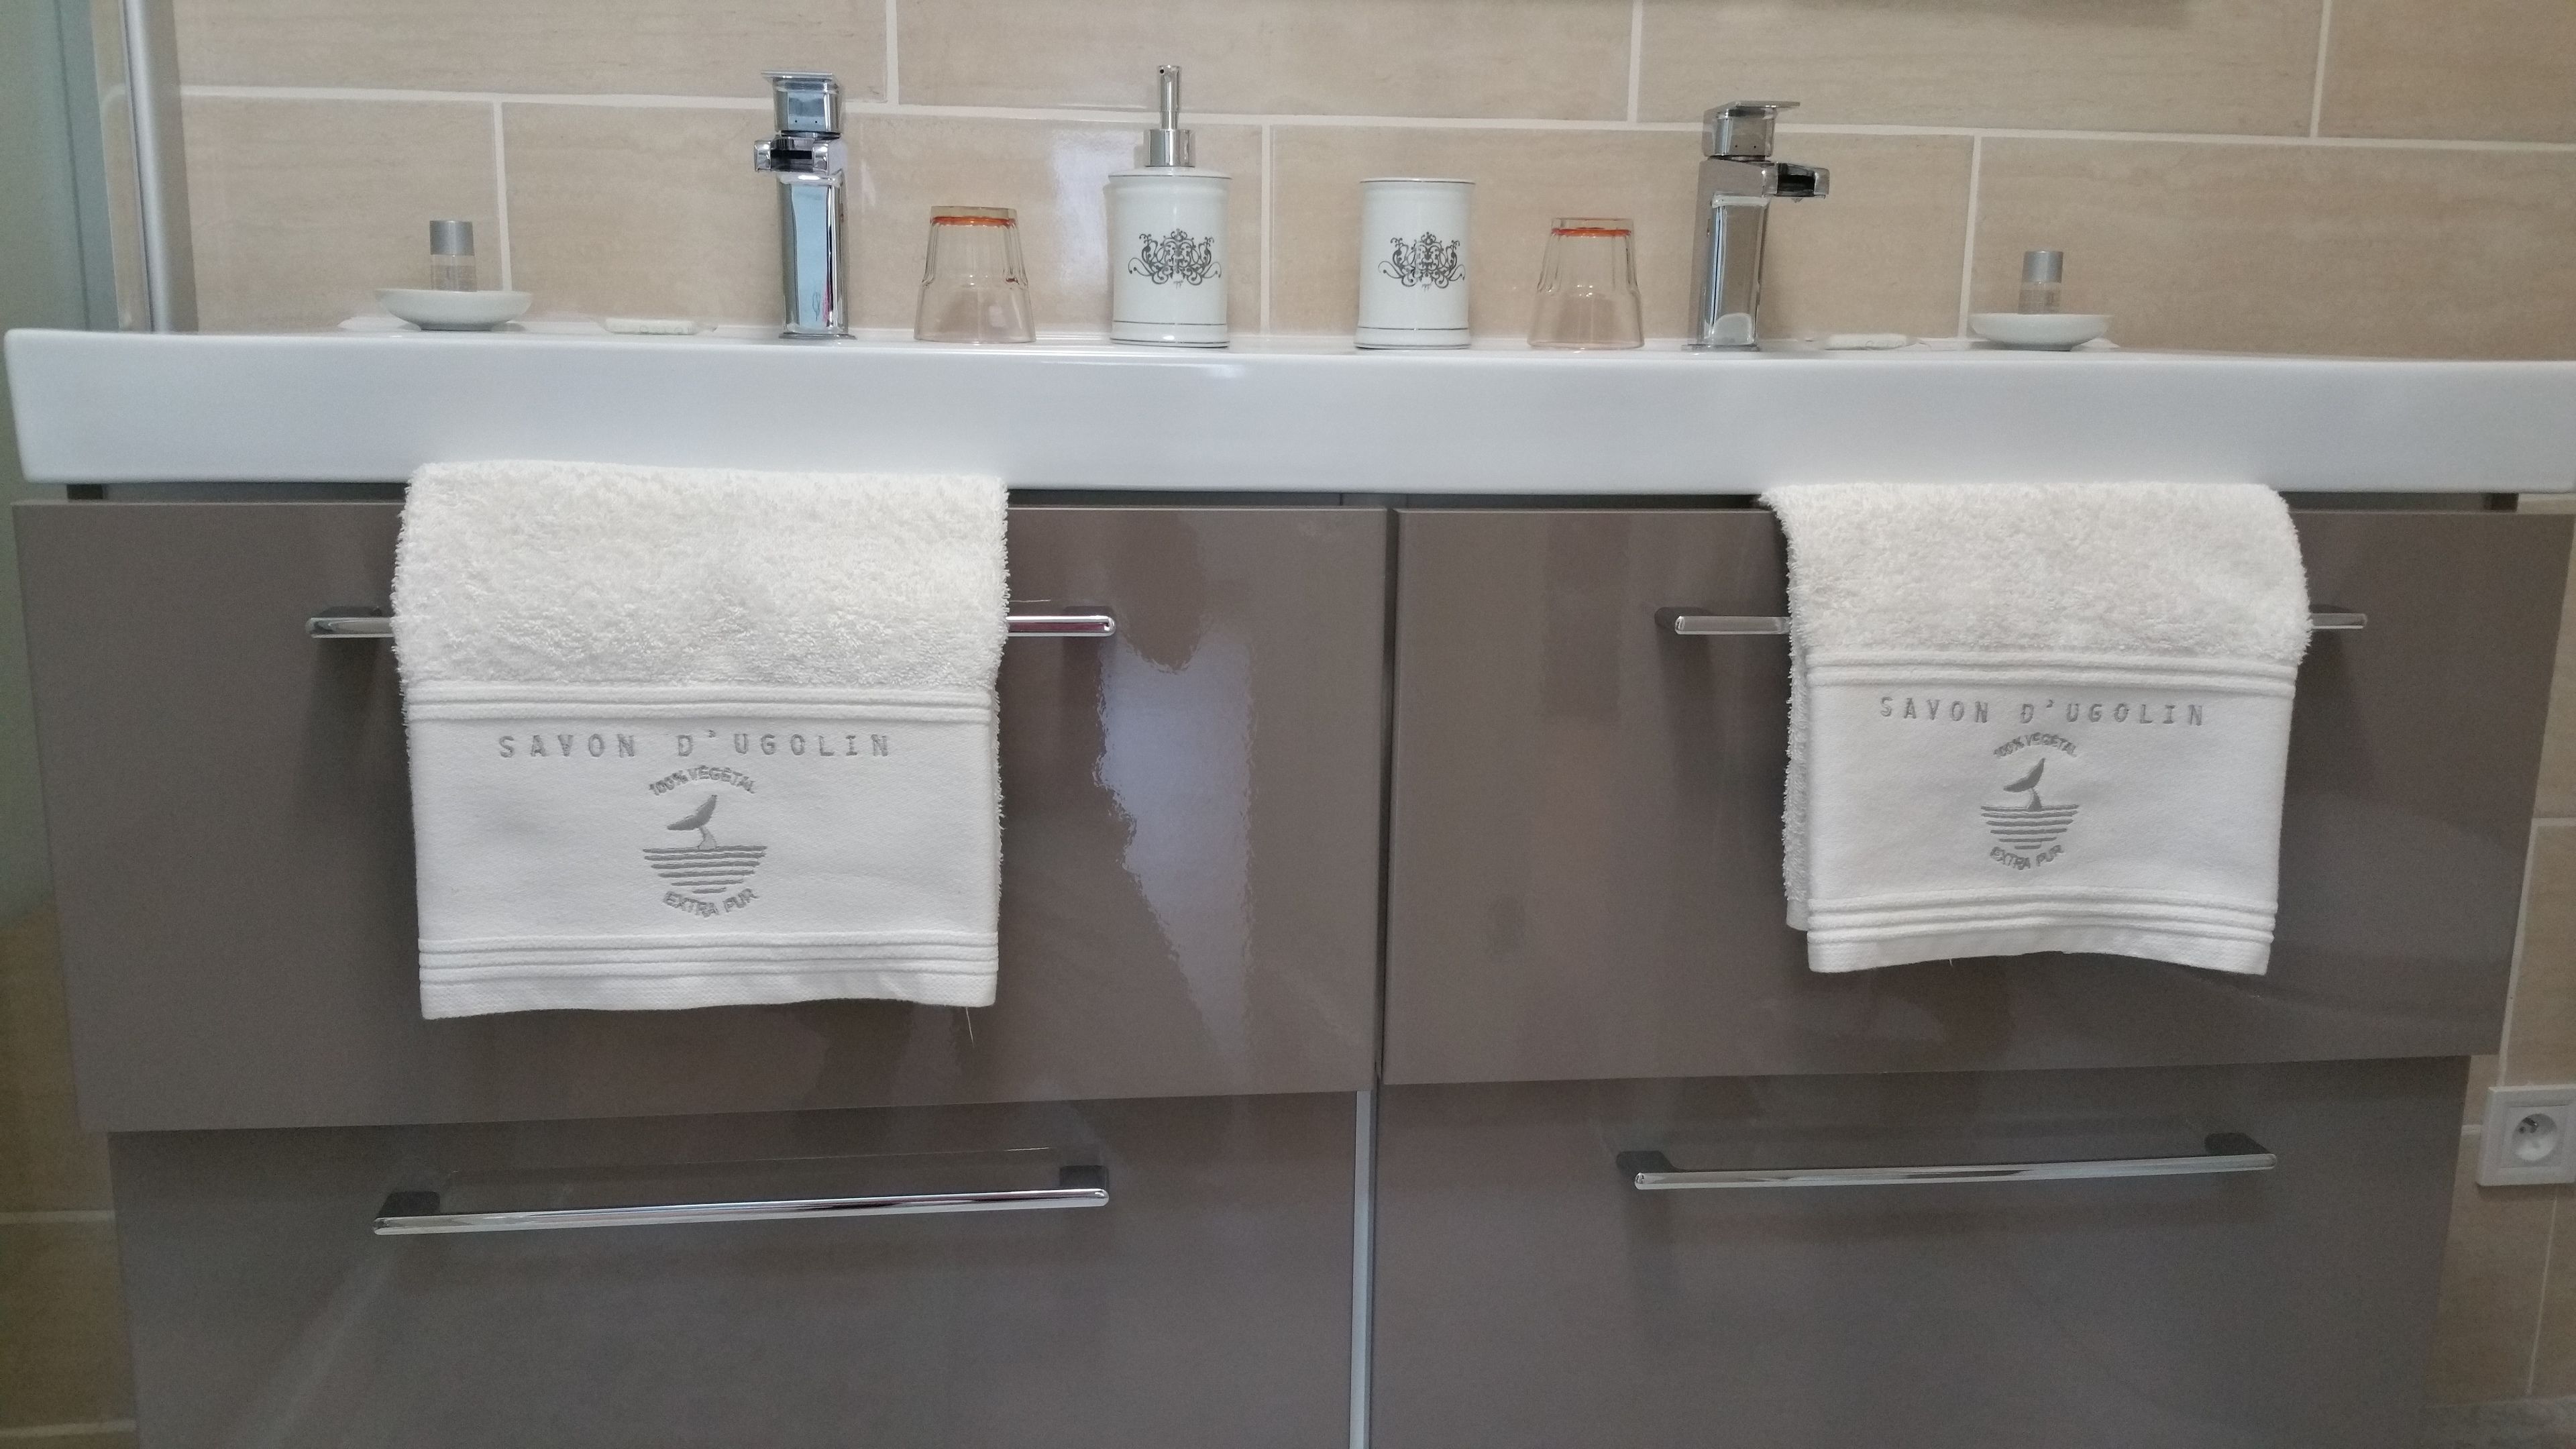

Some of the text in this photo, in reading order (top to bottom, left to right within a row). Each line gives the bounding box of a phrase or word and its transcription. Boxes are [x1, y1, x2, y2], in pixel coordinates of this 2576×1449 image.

[1880, 696, 2202, 727] SAVON D'UGOLIN
[499, 729, 889, 759] SAVON D'UGOLIN
[649, 769, 689, 796] 100%
[1990, 844, 2064, 871] EXTRA PUR
[663, 888, 759, 918] EXTRA PUR
